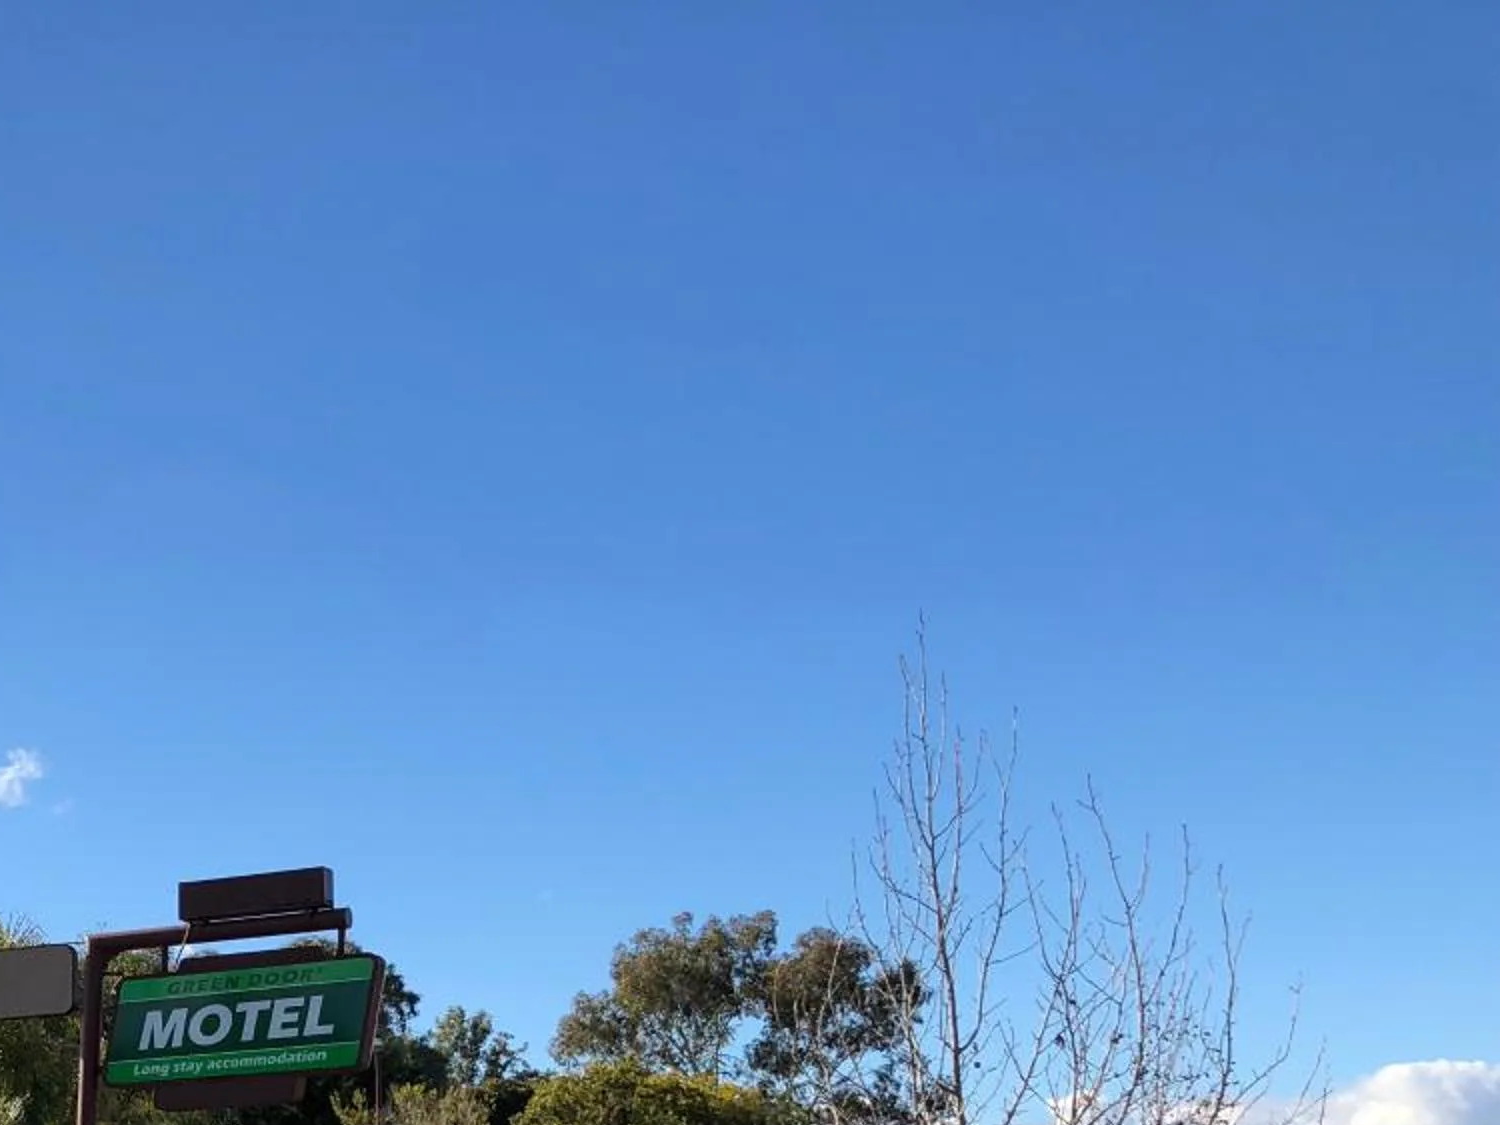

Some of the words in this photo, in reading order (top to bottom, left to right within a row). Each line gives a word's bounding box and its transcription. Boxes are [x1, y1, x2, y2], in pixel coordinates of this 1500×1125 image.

[167, 975, 240, 994] GREEN
[139, 995, 335, 1050] MOTEL
[133, 1063, 169, 1076] Long
[174, 1060, 203, 1074] stay
[206, 1050, 327, 1070] accommodation
